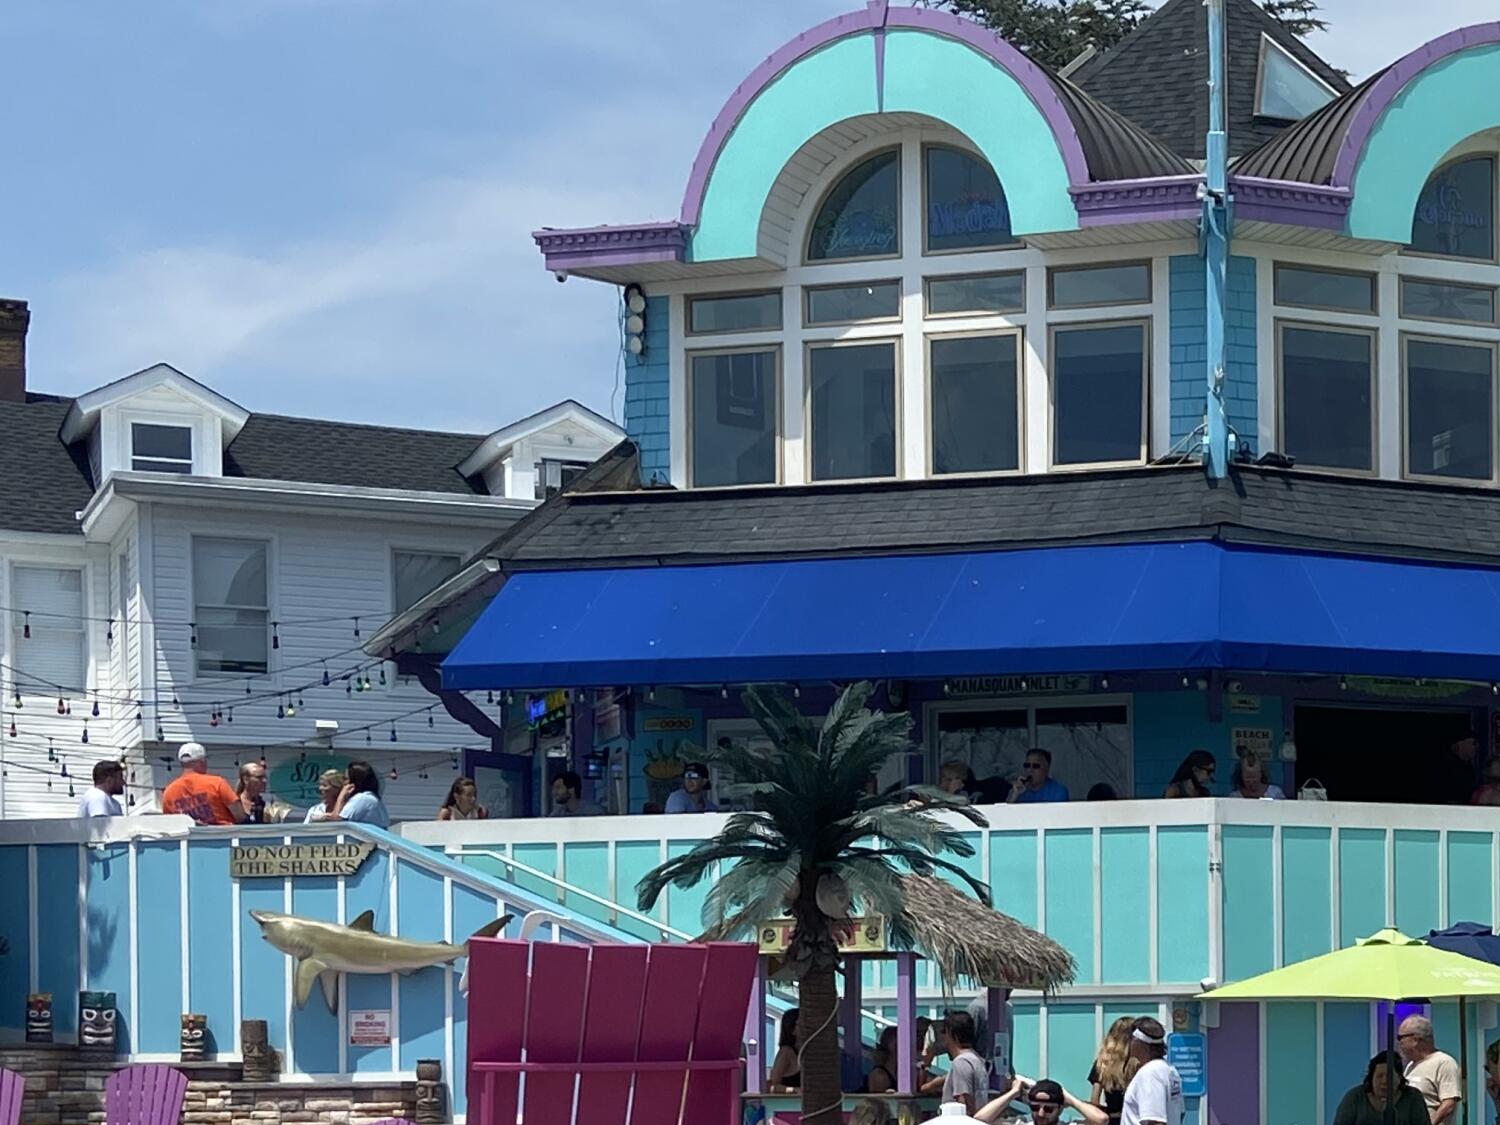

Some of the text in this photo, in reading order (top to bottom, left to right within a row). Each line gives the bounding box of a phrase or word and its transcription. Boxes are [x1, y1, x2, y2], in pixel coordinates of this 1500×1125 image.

[1235, 729, 1270, 739] BEACH
[233, 844, 360, 860] DO NOT FEED
[236, 859, 357, 875] THE SHARKS
